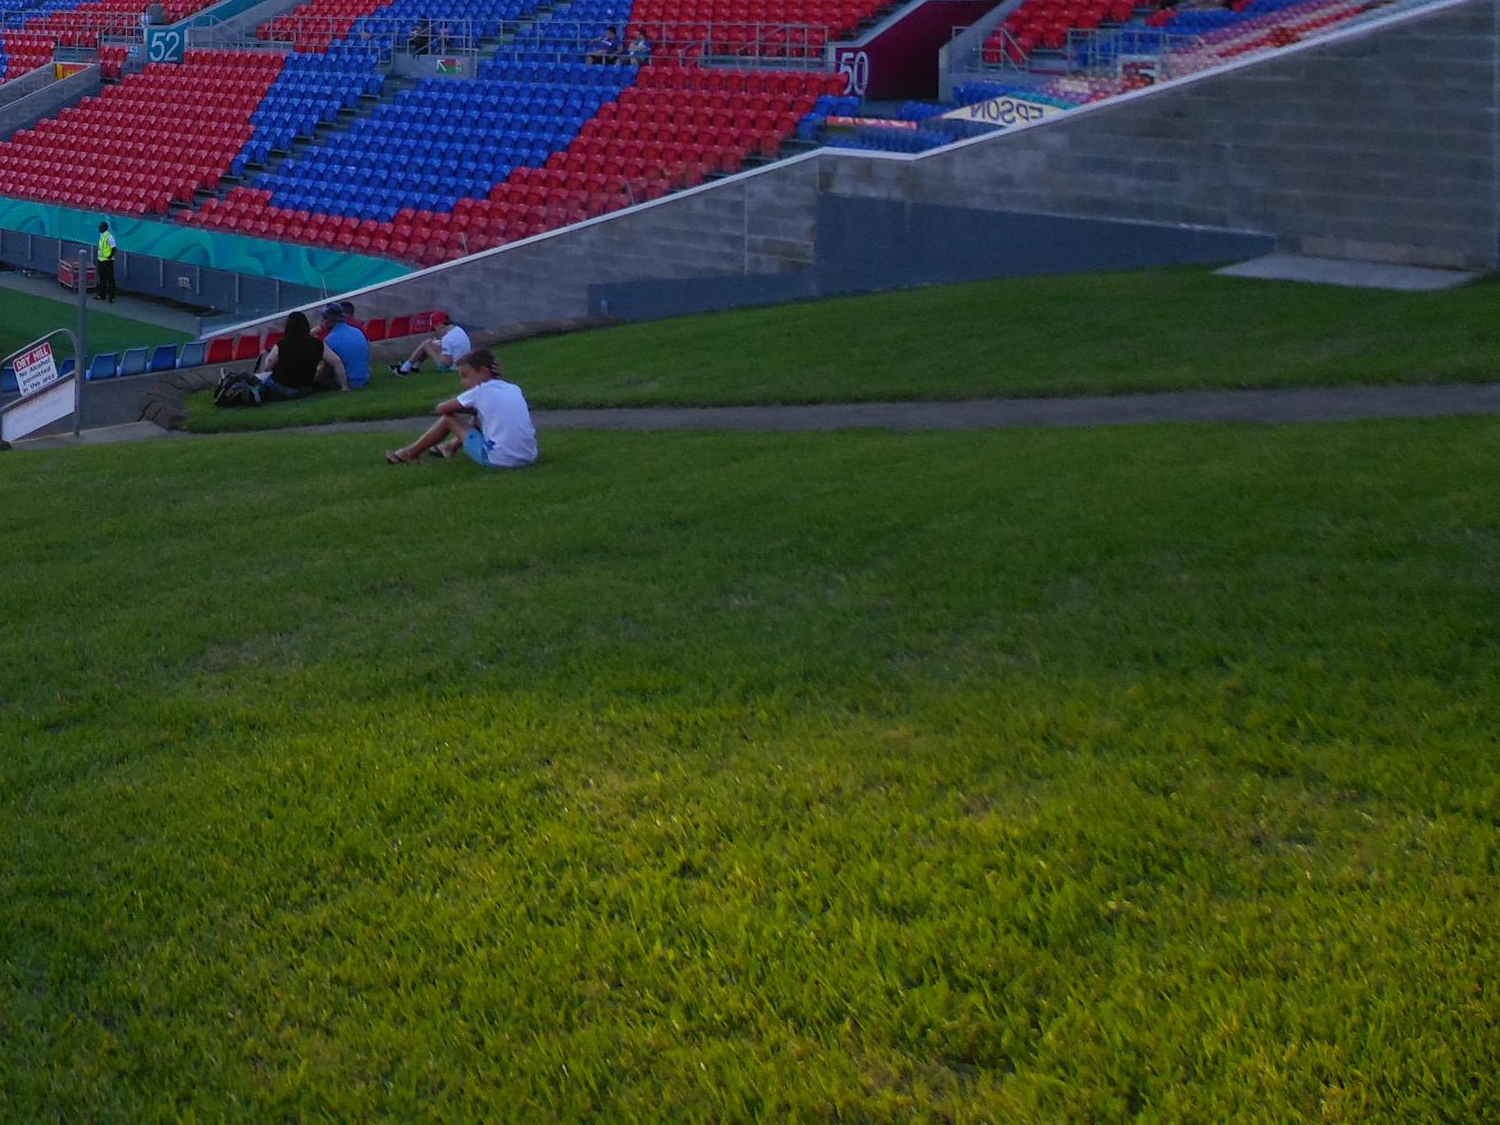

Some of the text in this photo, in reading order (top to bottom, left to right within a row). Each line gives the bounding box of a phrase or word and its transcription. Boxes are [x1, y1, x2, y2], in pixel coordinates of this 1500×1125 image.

[149, 31, 180, 62] 52
[837, 51, 869, 96] 50
[16, 346, 49, 370] DRY HILL
[19, 357, 51, 378] No Alcohol
[22, 366, 51, 386] permitted
[30, 380, 41, 390] this
[42, 374, 55, 383] area
